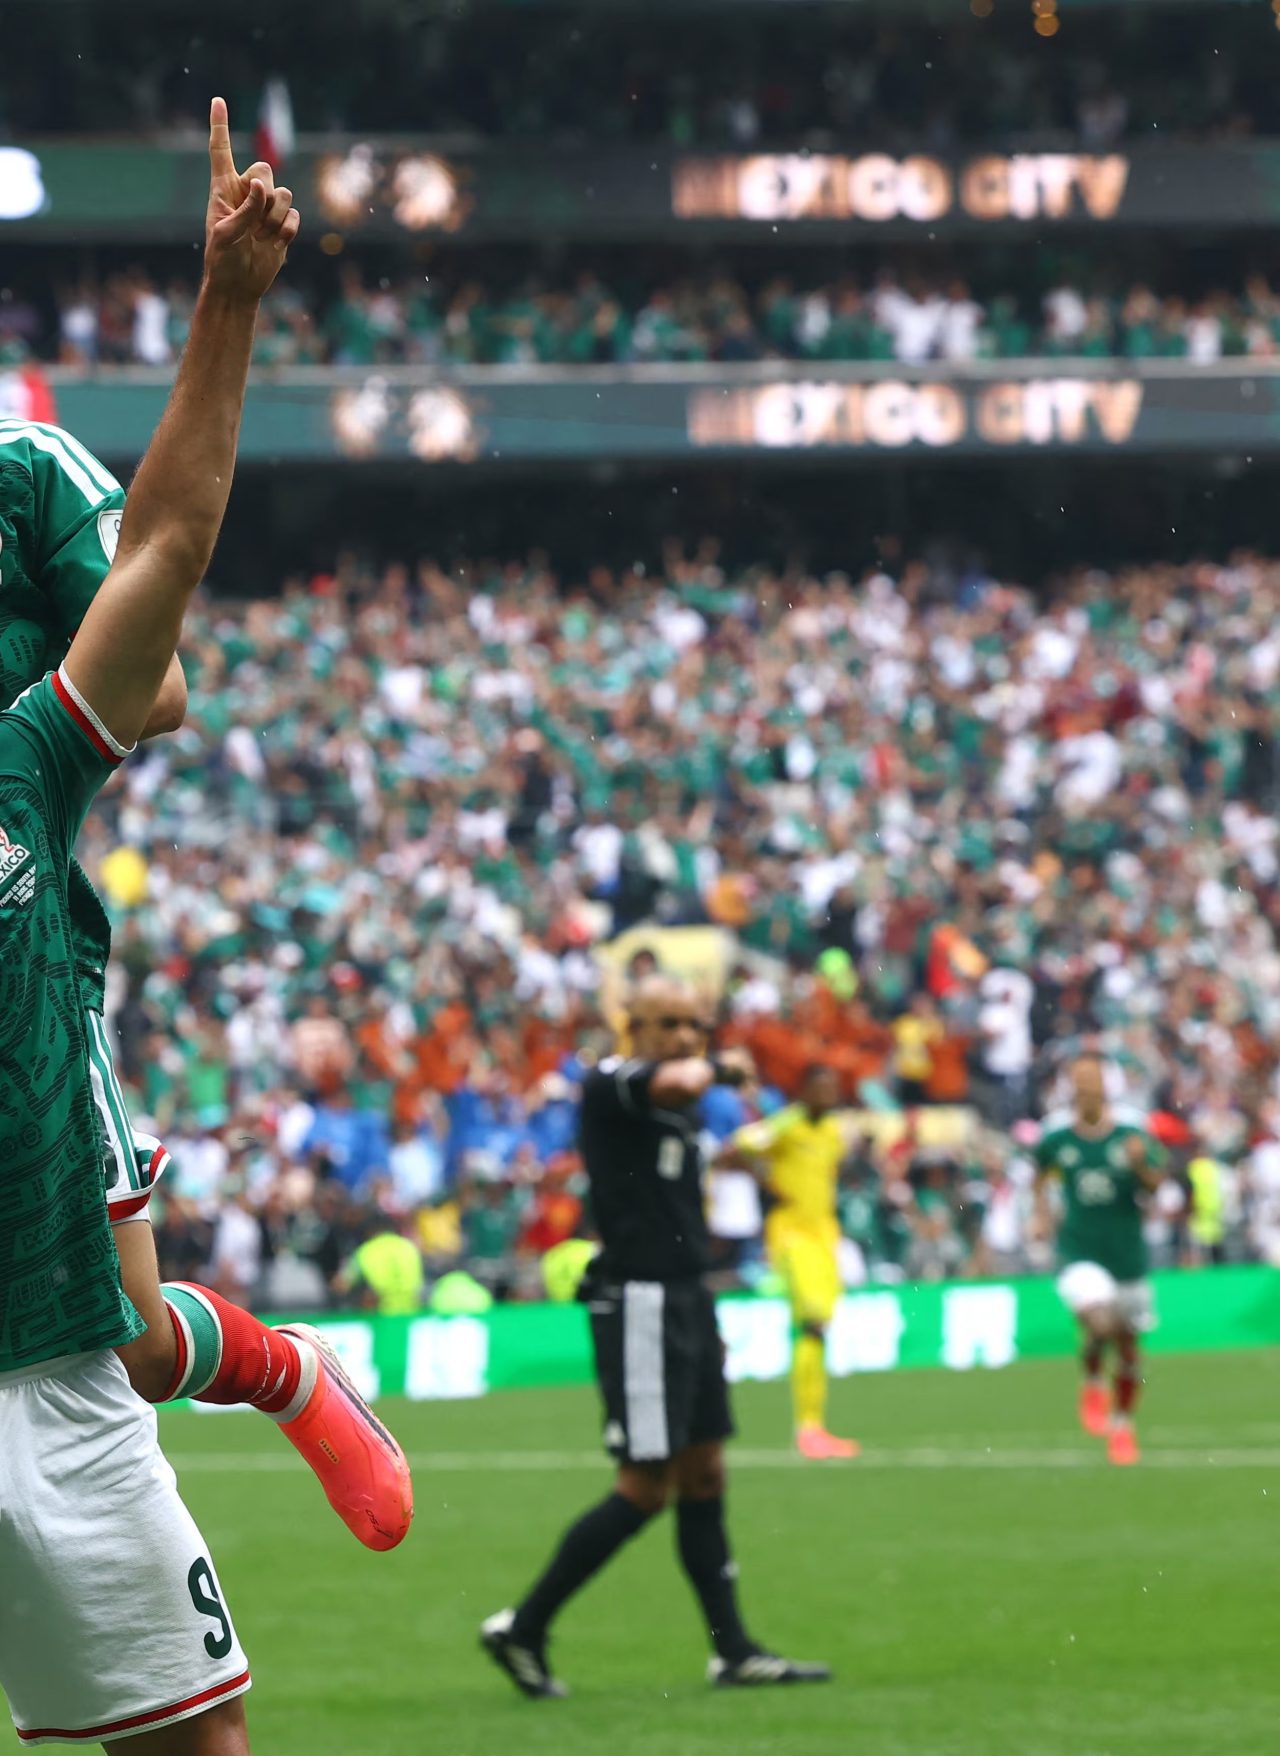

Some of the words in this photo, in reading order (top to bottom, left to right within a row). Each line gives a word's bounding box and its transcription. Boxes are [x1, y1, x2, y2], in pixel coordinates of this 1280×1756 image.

[960, 153, 1129, 221] CITY
[975, 380, 1144, 446] CITY
[187, 1556, 232, 1659] 9
